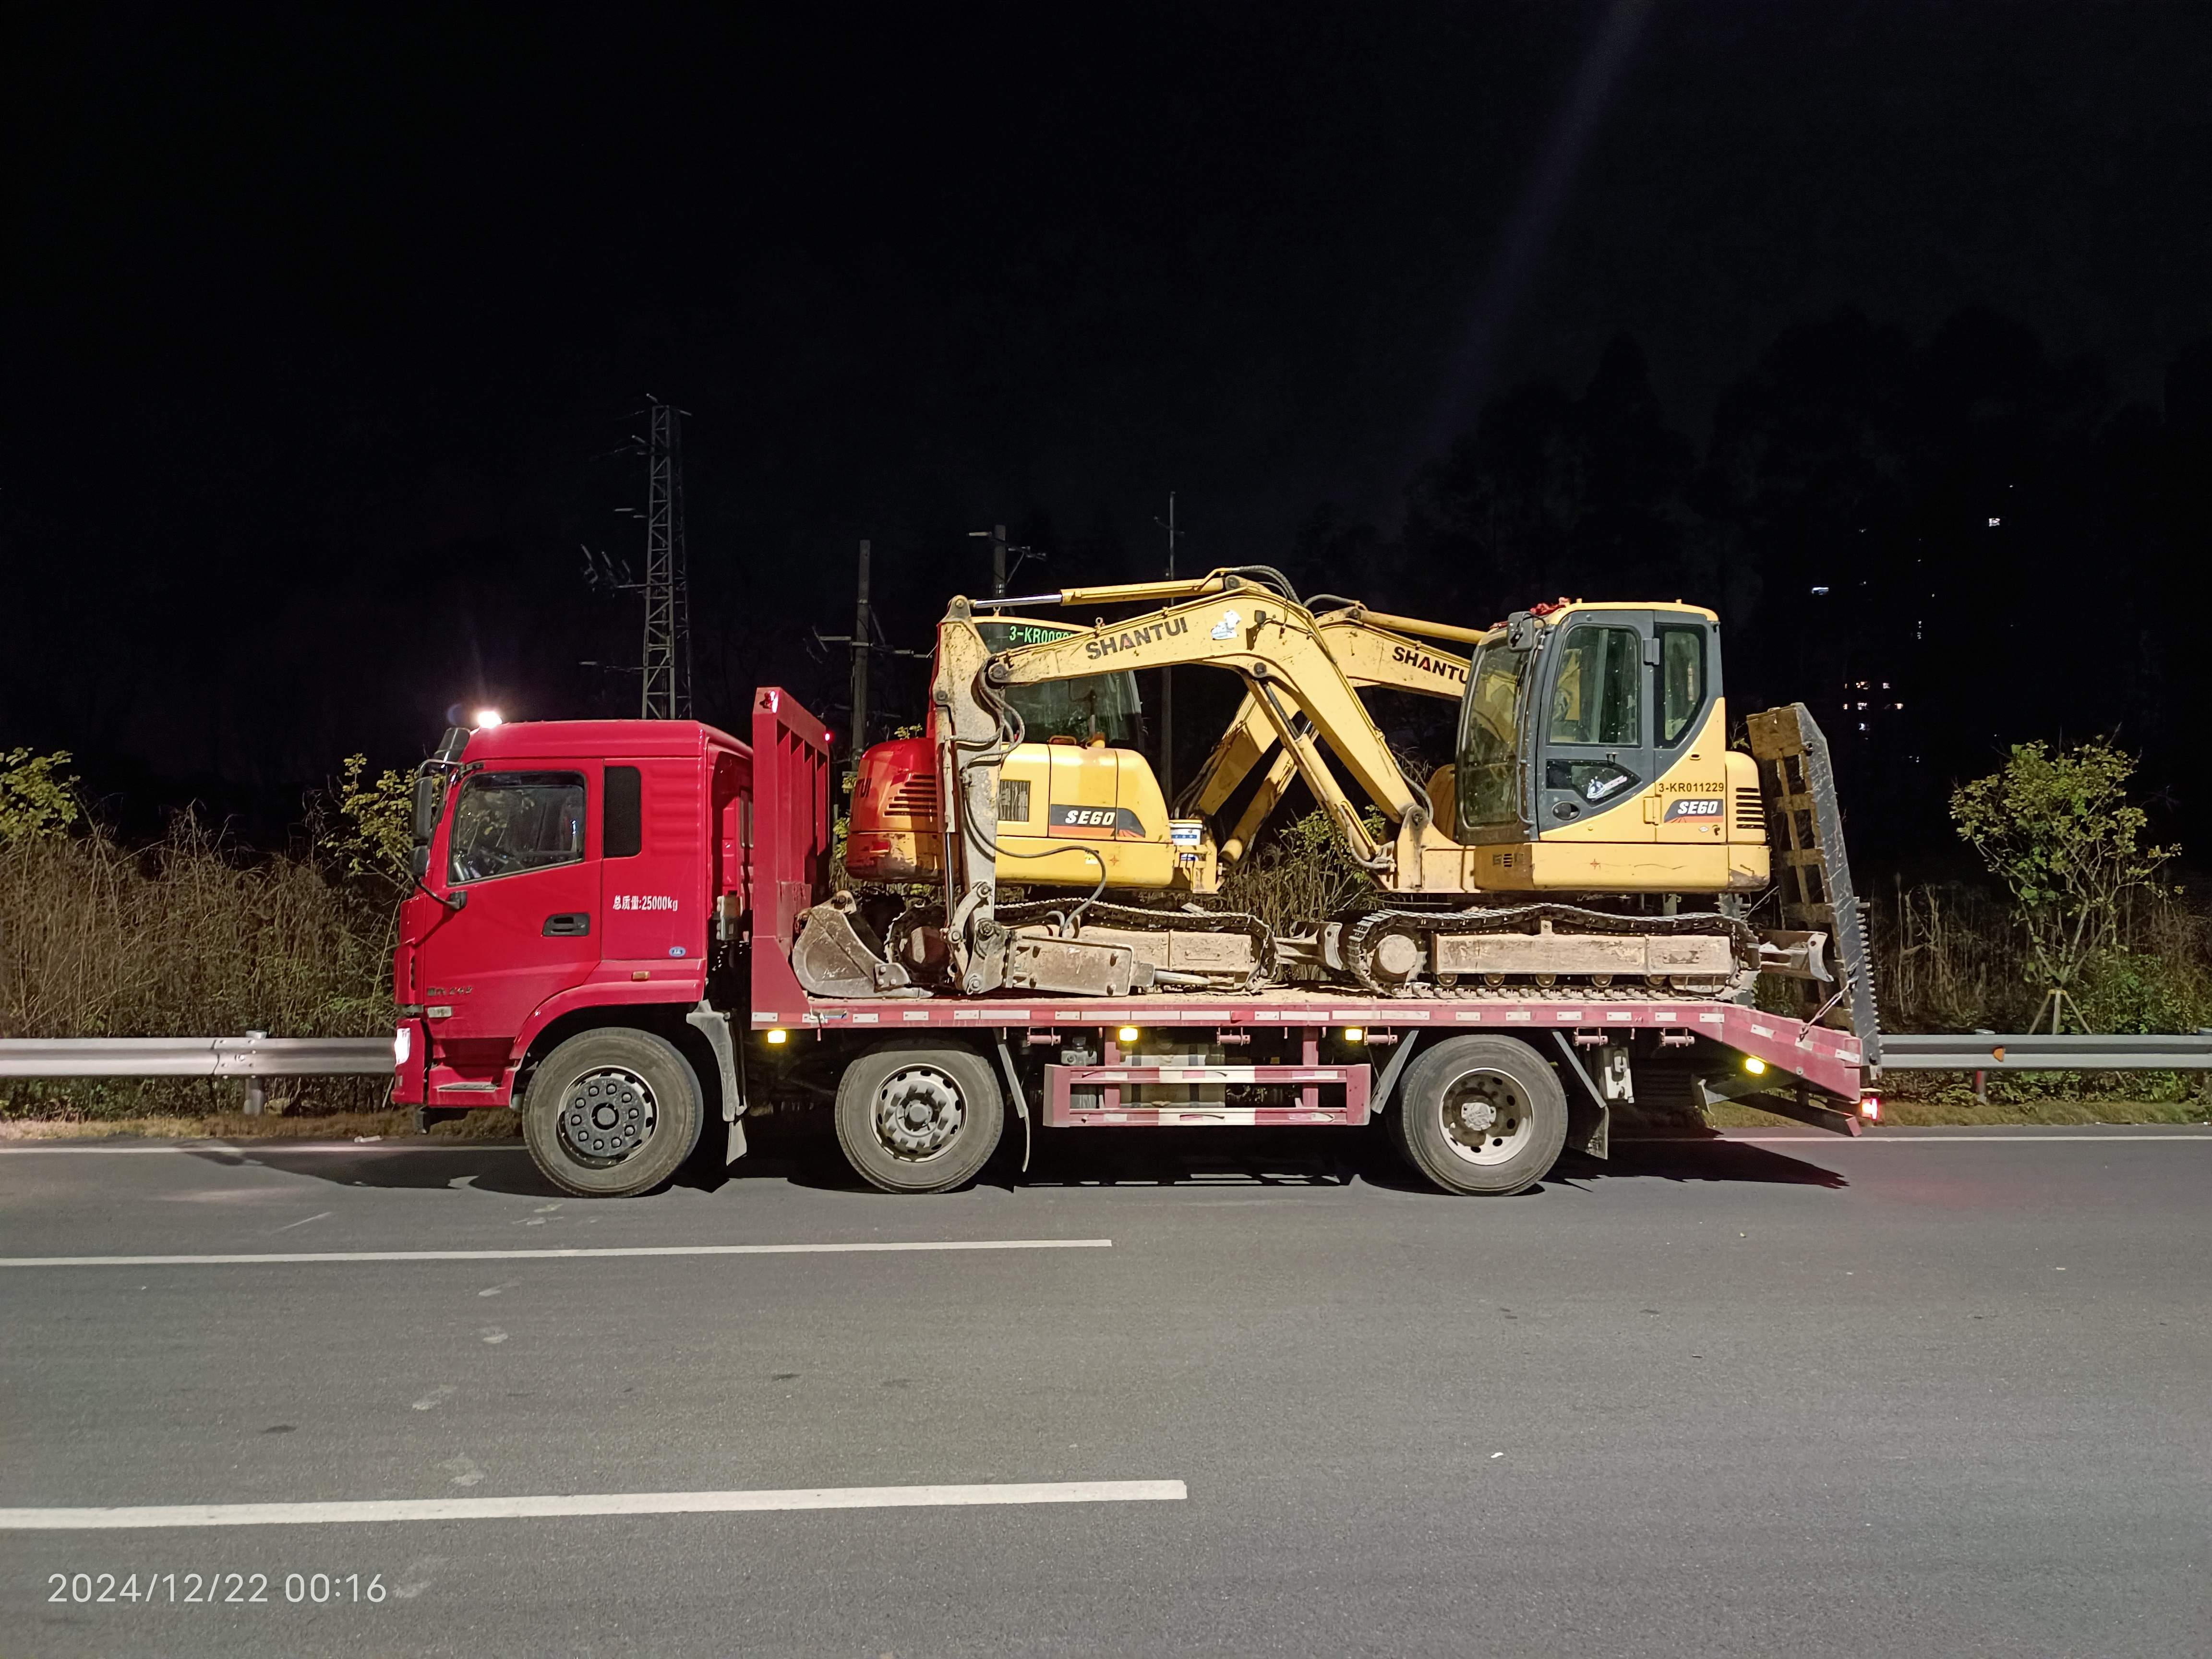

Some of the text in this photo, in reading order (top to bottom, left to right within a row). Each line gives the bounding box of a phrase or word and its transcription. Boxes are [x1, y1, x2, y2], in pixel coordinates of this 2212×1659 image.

[1086, 617, 1188, 660] SHANTUI
[1659, 782, 1724, 792] 3-KR011229
[1677, 801, 1718, 814] SE60
[1065, 810, 1116, 825] SE60
[613, 895, 678, 912] 总质量:25000kg
